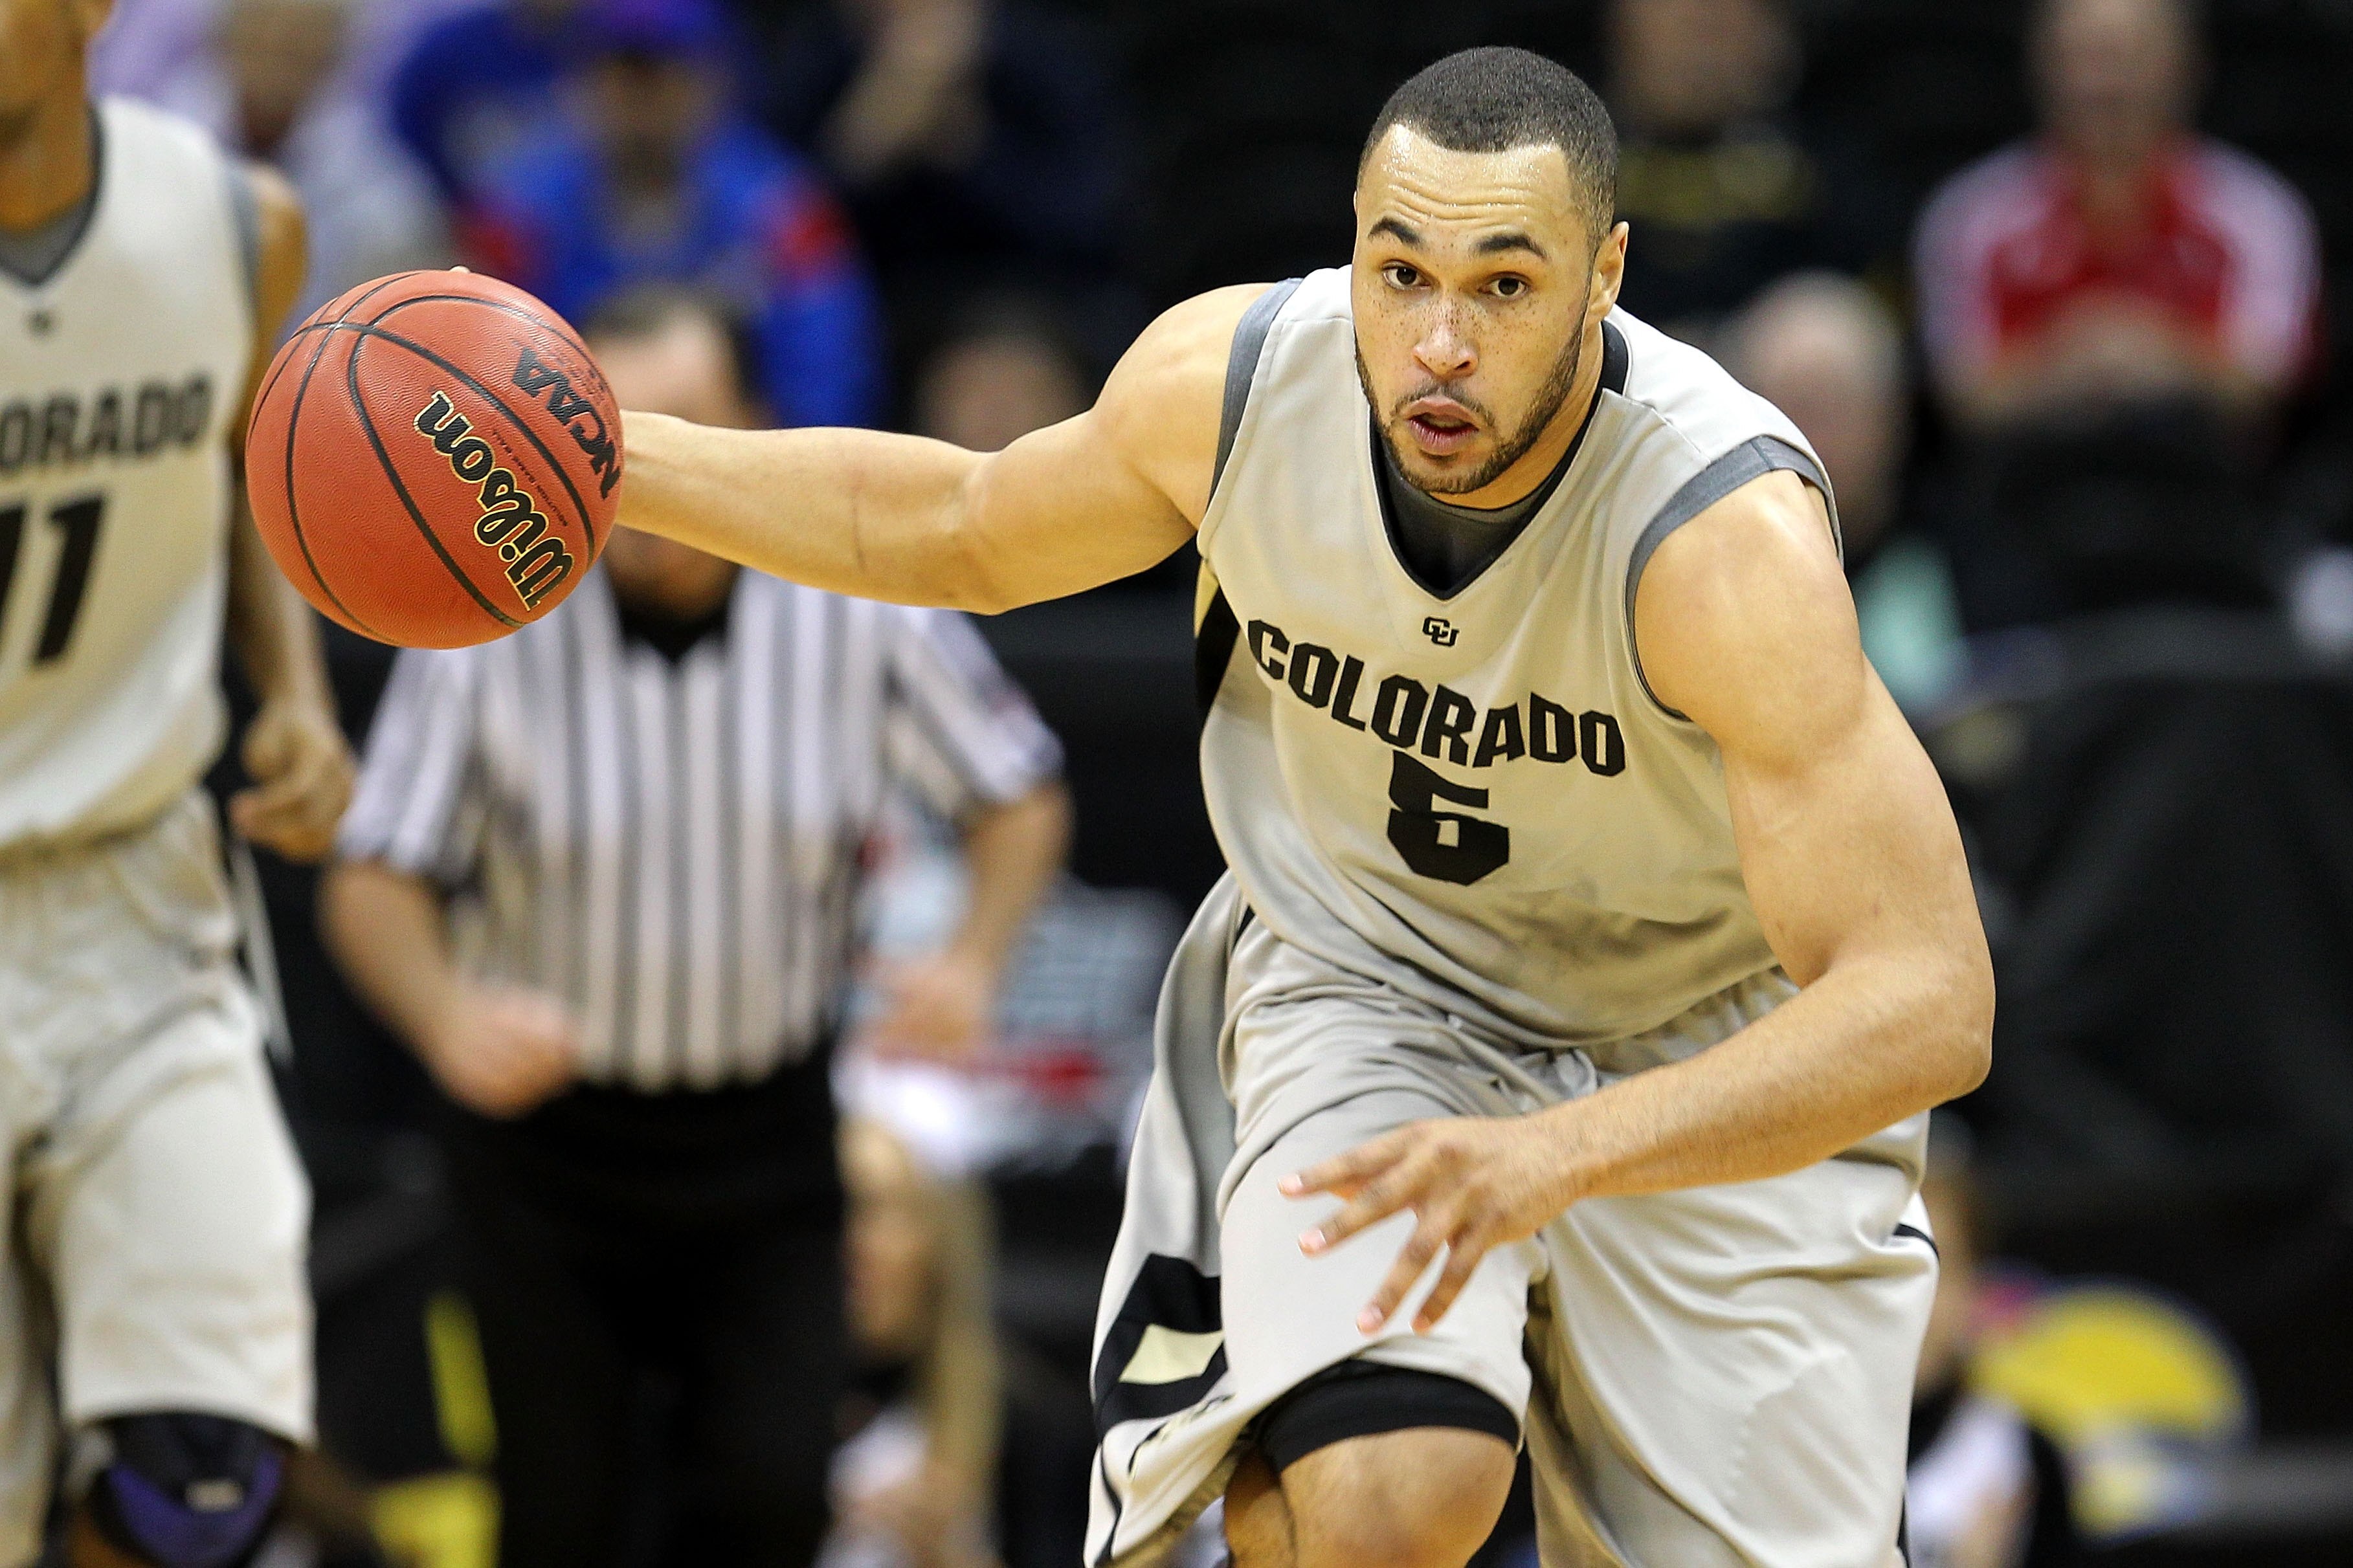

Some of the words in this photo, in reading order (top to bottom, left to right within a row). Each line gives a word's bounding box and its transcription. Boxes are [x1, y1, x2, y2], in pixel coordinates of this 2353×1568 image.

[413, 390, 574, 612] Wilson
[512, 347, 621, 500] NCAA
[1247, 619, 1625, 777] COLORADO
